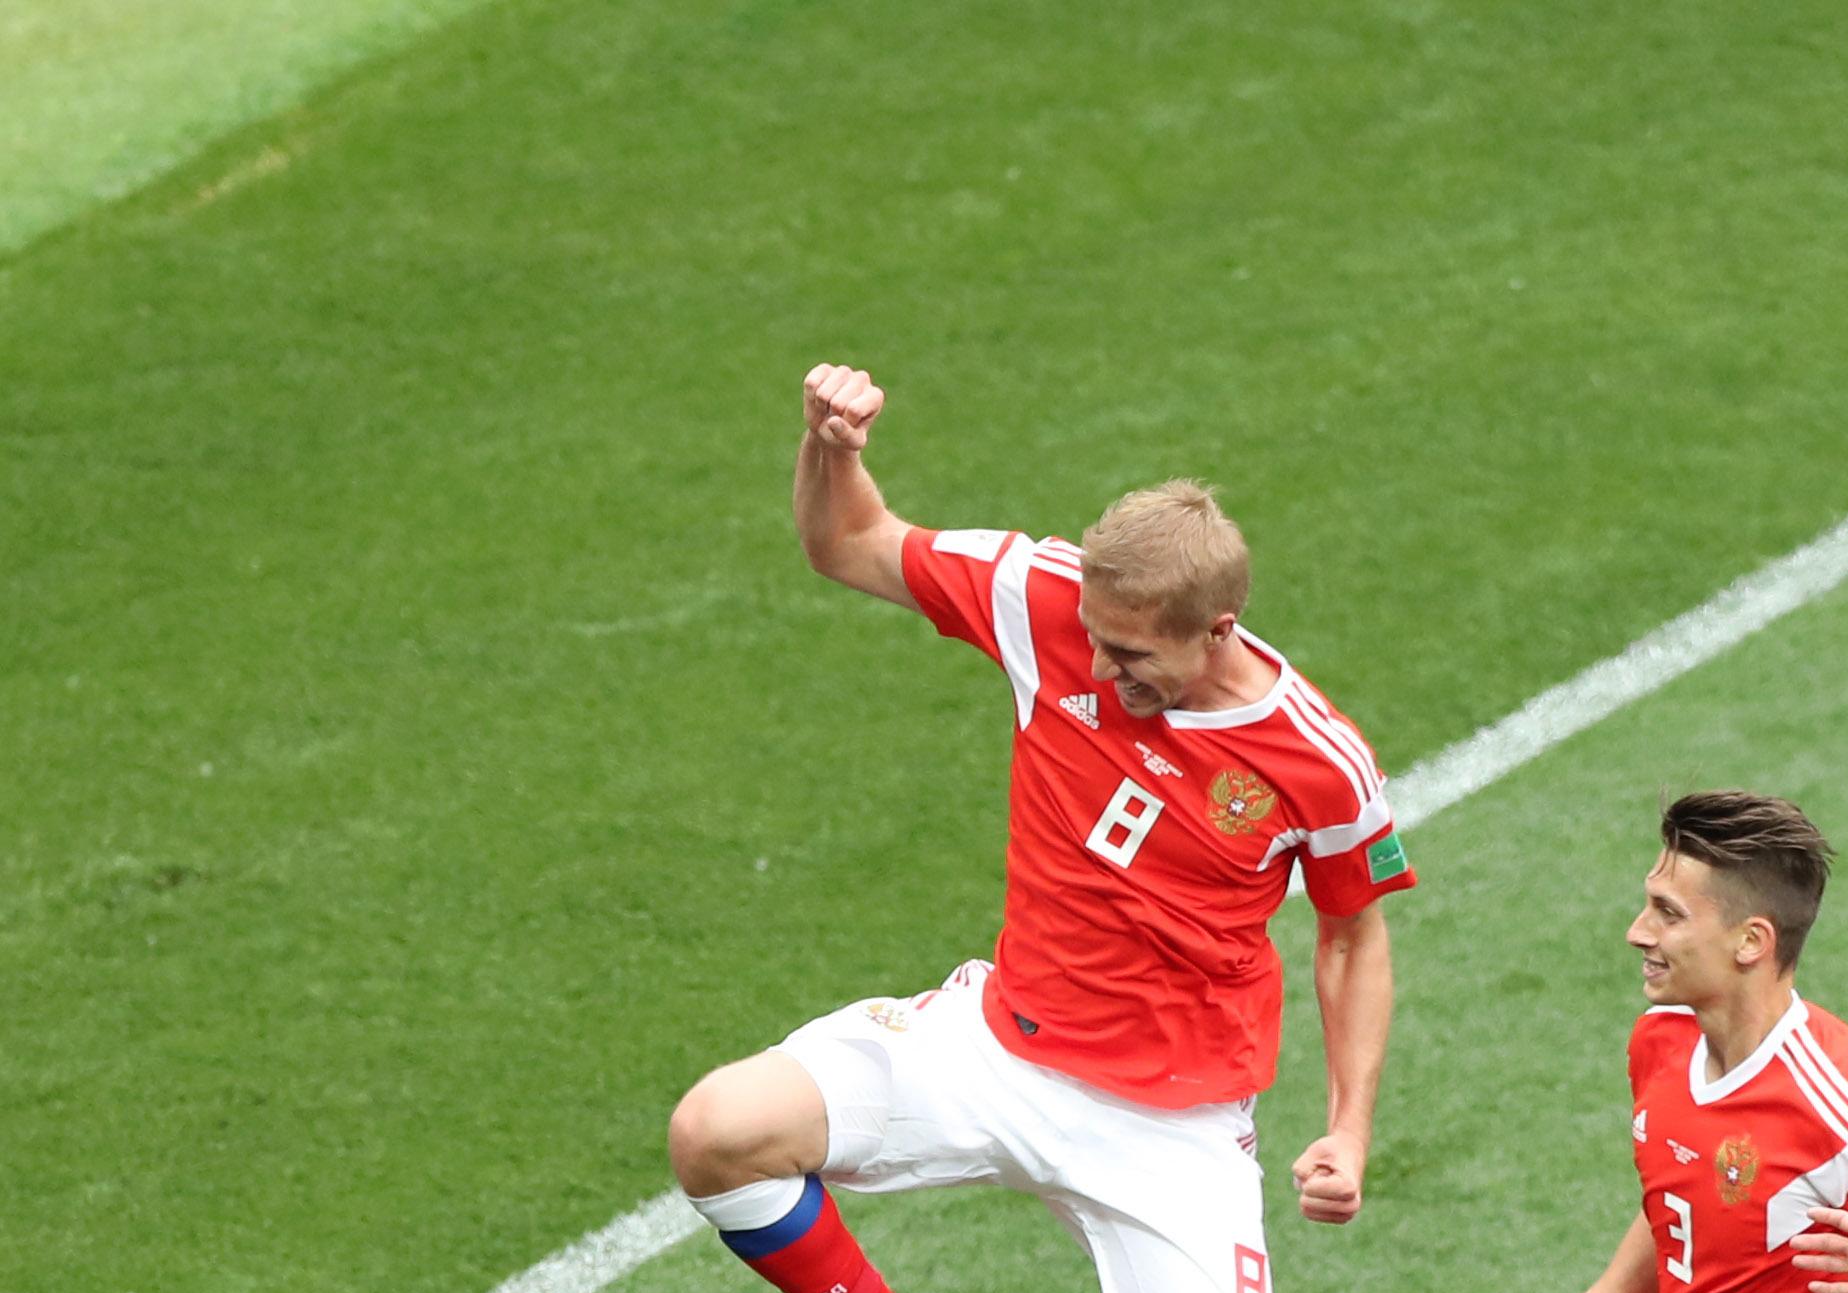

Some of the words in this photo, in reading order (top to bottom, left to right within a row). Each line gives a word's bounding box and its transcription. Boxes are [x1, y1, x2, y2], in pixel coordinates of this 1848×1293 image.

[1058, 697, 1100, 730] adidas
[1084, 776, 1166, 870] 8
[1663, 1191, 1693, 1285] 3
